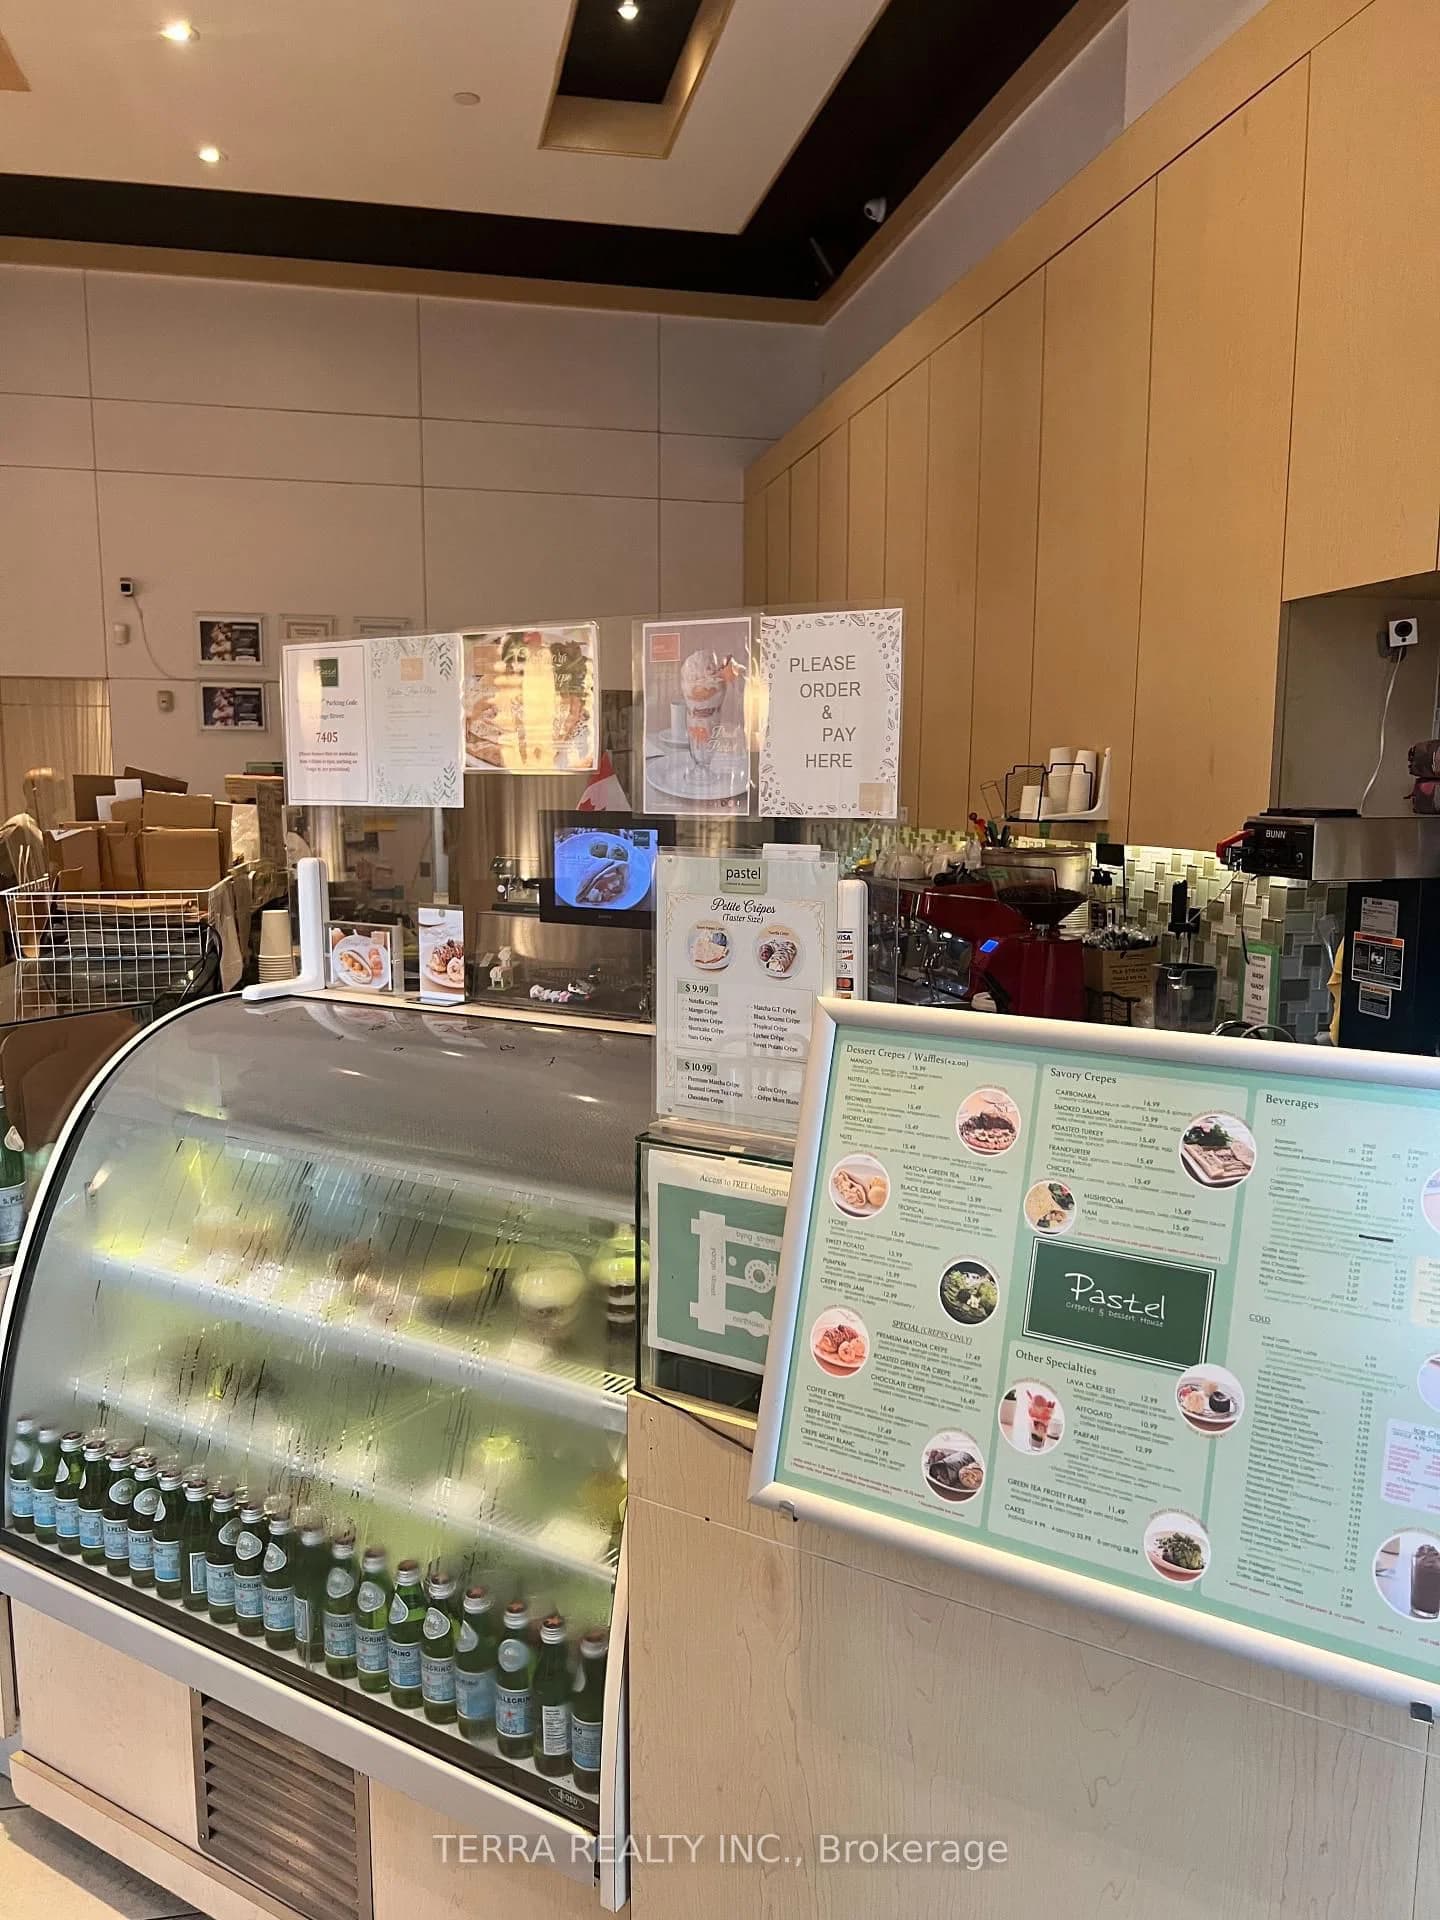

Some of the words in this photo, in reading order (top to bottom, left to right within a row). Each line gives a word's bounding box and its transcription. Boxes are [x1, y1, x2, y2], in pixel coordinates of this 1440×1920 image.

[790, 655, 857, 672] PLEASE
[800, 682, 861, 698] ORDER
[822, 705, 832, 720] &
[316, 732, 338, 743] 7405
[822, 727, 857, 742] PAY
[805, 754, 853, 768] HERE
[1265, 830, 1286, 839] BUNN
[726, 867, 761, 881] pastel
[710, 898, 740, 912] Petite
[743, 900, 775, 914] Crêpes
[722, 914, 745, 923] (Taster
[747, 915, 764, 924] Size)
[685, 984, 690, 992] $
[692, 985, 708, 993] 9.99
[846, 1045, 876, 1057] Dessert
[878, 1048, 906, 1060] Crepes
[908, 1052, 912, 1060] /
[685, 1062, 690, 1070] $
[692, 1063, 712, 1072] 10.99
[848, 1076, 870, 1084] NUTELLA
[1050, 1068, 1082, 1082] Savory
[1084, 1072, 1117, 1084] Crepes
[1055, 1089, 1096, 1100] CARBONARA
[1266, 1094, 1320, 1109] Beverages
[1053, 1104, 1081, 1114] SMOKED
[1082, 1107, 1110, 1116] SALMON
[1142, 1115, 1158, 1123] 15.99
[1271, 1118, 1287, 1126] HOT
[1051, 1125, 1080, 1134] ROASTED
[1081, 1128, 1104, 1137] TURKEY
[1139, 1136, 1156, 1144] 15.49
[1049, 1144, 1091, 1155] FRANKFURTER
[1136, 1157, 1153, 1165] 15.49
[903, 1164, 927, 1174] MATCHA
[929, 1168, 949, 1177] GREEN
[1046, 1164, 1075, 1174] CHICKEN
[700, 1174, 723, 1185] Access
[724, 1178, 731, 1186] to
[732, 1179, 749, 1190] FREE
[750, 1183, 788, 1198] Undergrou
[900, 1184, 918, 1192] BLACK
[919, 1187, 942, 1196] SESAME
[1084, 1193, 1124, 1204] MUSHROOM
[1174, 1208, 1192, 1216] 15.49
[898, 1204, 924, 1214] TROPICAL
[964, 1216, 979, 1224] 15.99
[1082, 1208, 1098, 1216] HAM
[1172, 1224, 1190, 1232] 15.49
[891, 1230, 905, 1238] 15.99
[825, 1238, 842, 1246] SWEET
[843, 1241, 865, 1250] POTATO
[888, 1250, 903, 1258] 15.99
[822, 1258, 847, 1267] PUMPKIN
[820, 1278, 838, 1286] CREPE
[1064, 1272, 1166, 1320] Pastel
[1108, 1311, 1135, 1322] Dessert
[1249, 1313, 1271, 1324] COLD
[892, 1320, 920, 1332] SPECIAL
[921, 1325, 948, 1339] (CREPES
[949, 1331, 973, 1345] ONLY)
[876, 1332, 902, 1343] PREMIUM
[903, 1337, 928, 1348] MATCHA
[929, 1343, 948, 1353] CREPE
[873, 1353, 899, 1364] ROASTED
[900, 1358, 920, 1369] GREEN
[921, 1363, 931, 1372] TEA
[932, 1366, 951, 1376] CREPE
[1016, 1350, 1044, 1365] Other
[1046, 1356, 1097, 1376] Specialties
[870, 1373, 907, 1387] CHOCOLATE
[907, 1382, 926, 1392] CREPE
[1066, 1378, 1085, 1388] LAVA
[1086, 1382, 1104, 1392] CAKE
[1105, 1387, 1116, 1395] SET
[806, 1385, 827, 1394] COFFEE
[827, 1390, 846, 1399] CREPE
[803, 1406, 821, 1416] CREPE
[1075, 1405, 1113, 1419] AFFOGATO
[1140, 1420, 1158, 1430] 10.99
[800, 1427, 819, 1438] CREPE
[820, 1433, 835, 1442] MONT
[836, 1437, 856, 1447] BLANC
[1073, 1429, 1100, 1441] PARFAIT
[1135, 1445, 1152, 1454] 12.99
[1007, 1478, 1030, 1489] GREEN
[1030, 1483, 1042, 1492] TEA
[1043, 1486, 1066, 1499] FROSTY
[1067, 1492, 1087, 1504] FLAKE
[1108, 1504, 1125, 1515] 11.49
[1004, 1504, 1025, 1515] CAKES
